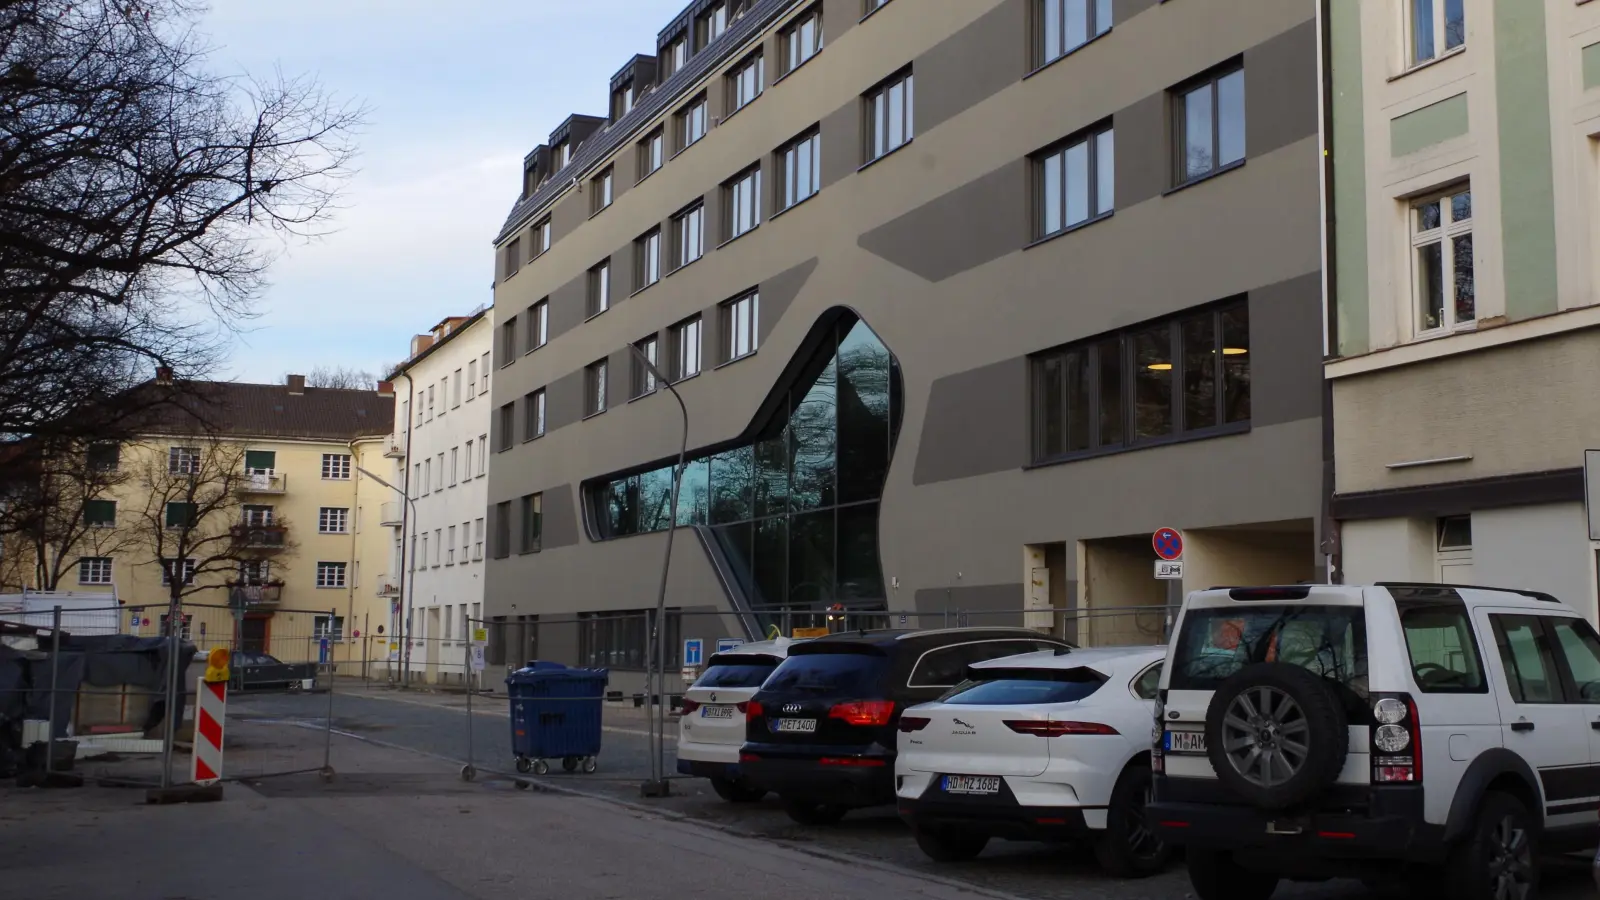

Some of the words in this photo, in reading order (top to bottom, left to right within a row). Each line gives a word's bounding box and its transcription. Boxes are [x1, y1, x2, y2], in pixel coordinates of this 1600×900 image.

[1175, 734, 1182, 748] M
[947, 776, 958, 788] HD
[964, 778, 975, 790] HZ
[976, 778, 998, 791] 168E
